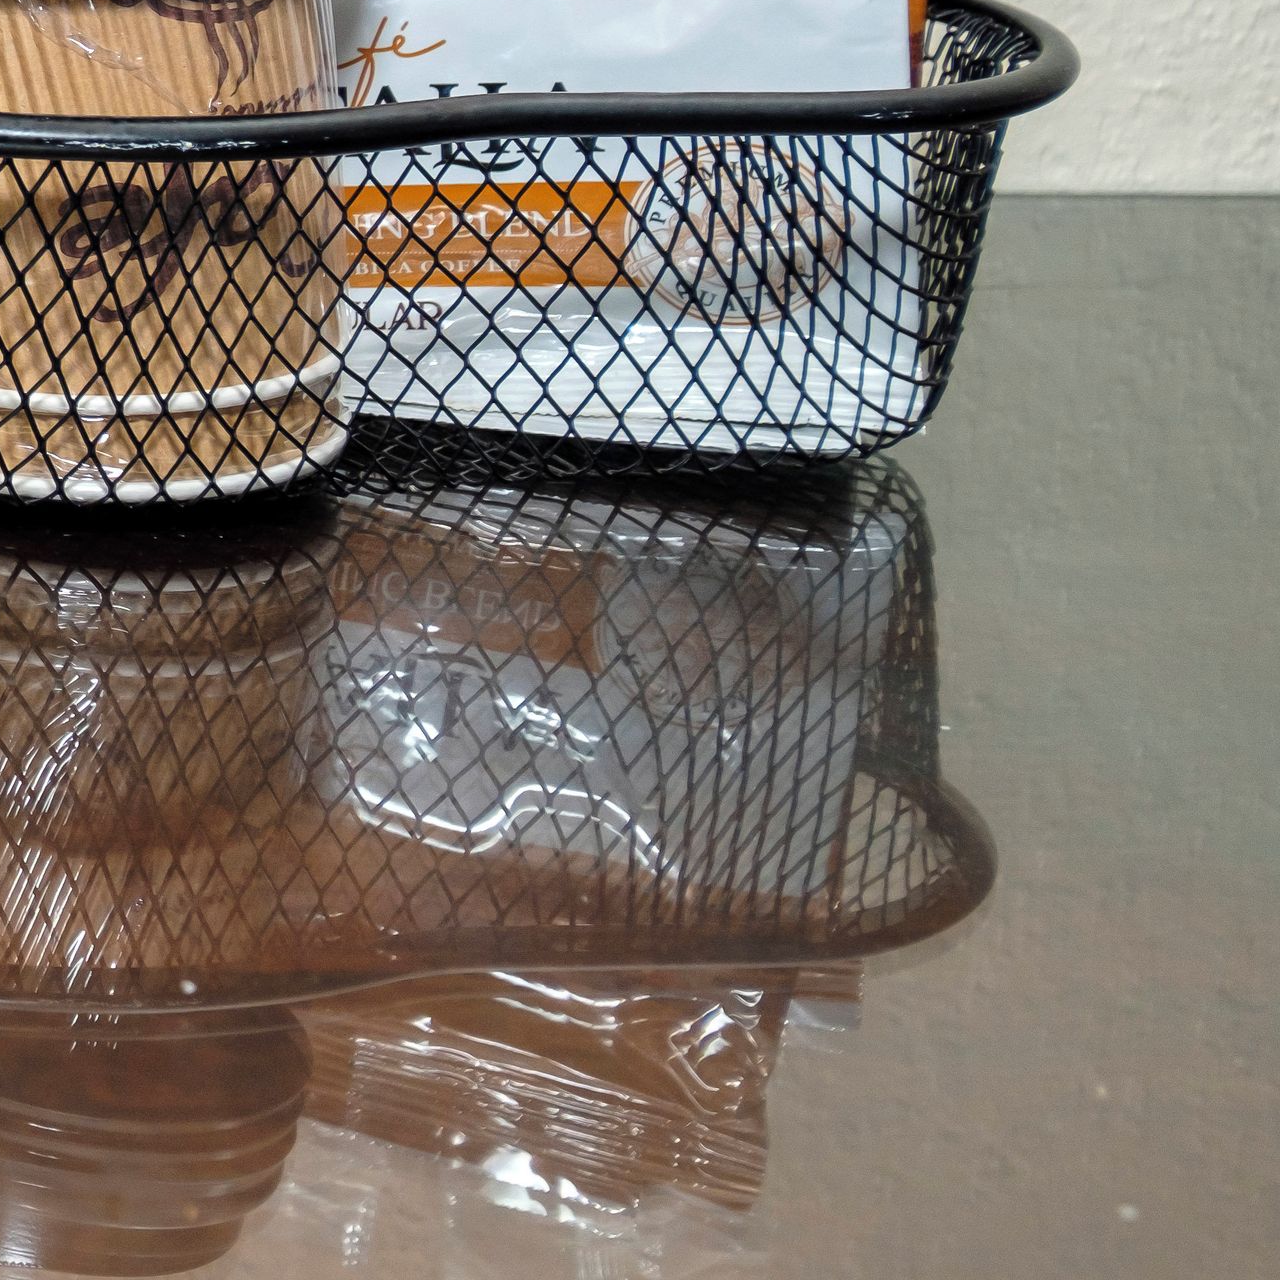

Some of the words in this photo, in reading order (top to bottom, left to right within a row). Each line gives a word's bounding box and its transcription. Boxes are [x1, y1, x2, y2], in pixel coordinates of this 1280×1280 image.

[337, 15, 447, 108] fé
[452, 209, 593, 240] BLEND
[420, 258, 521, 273] COFEE
